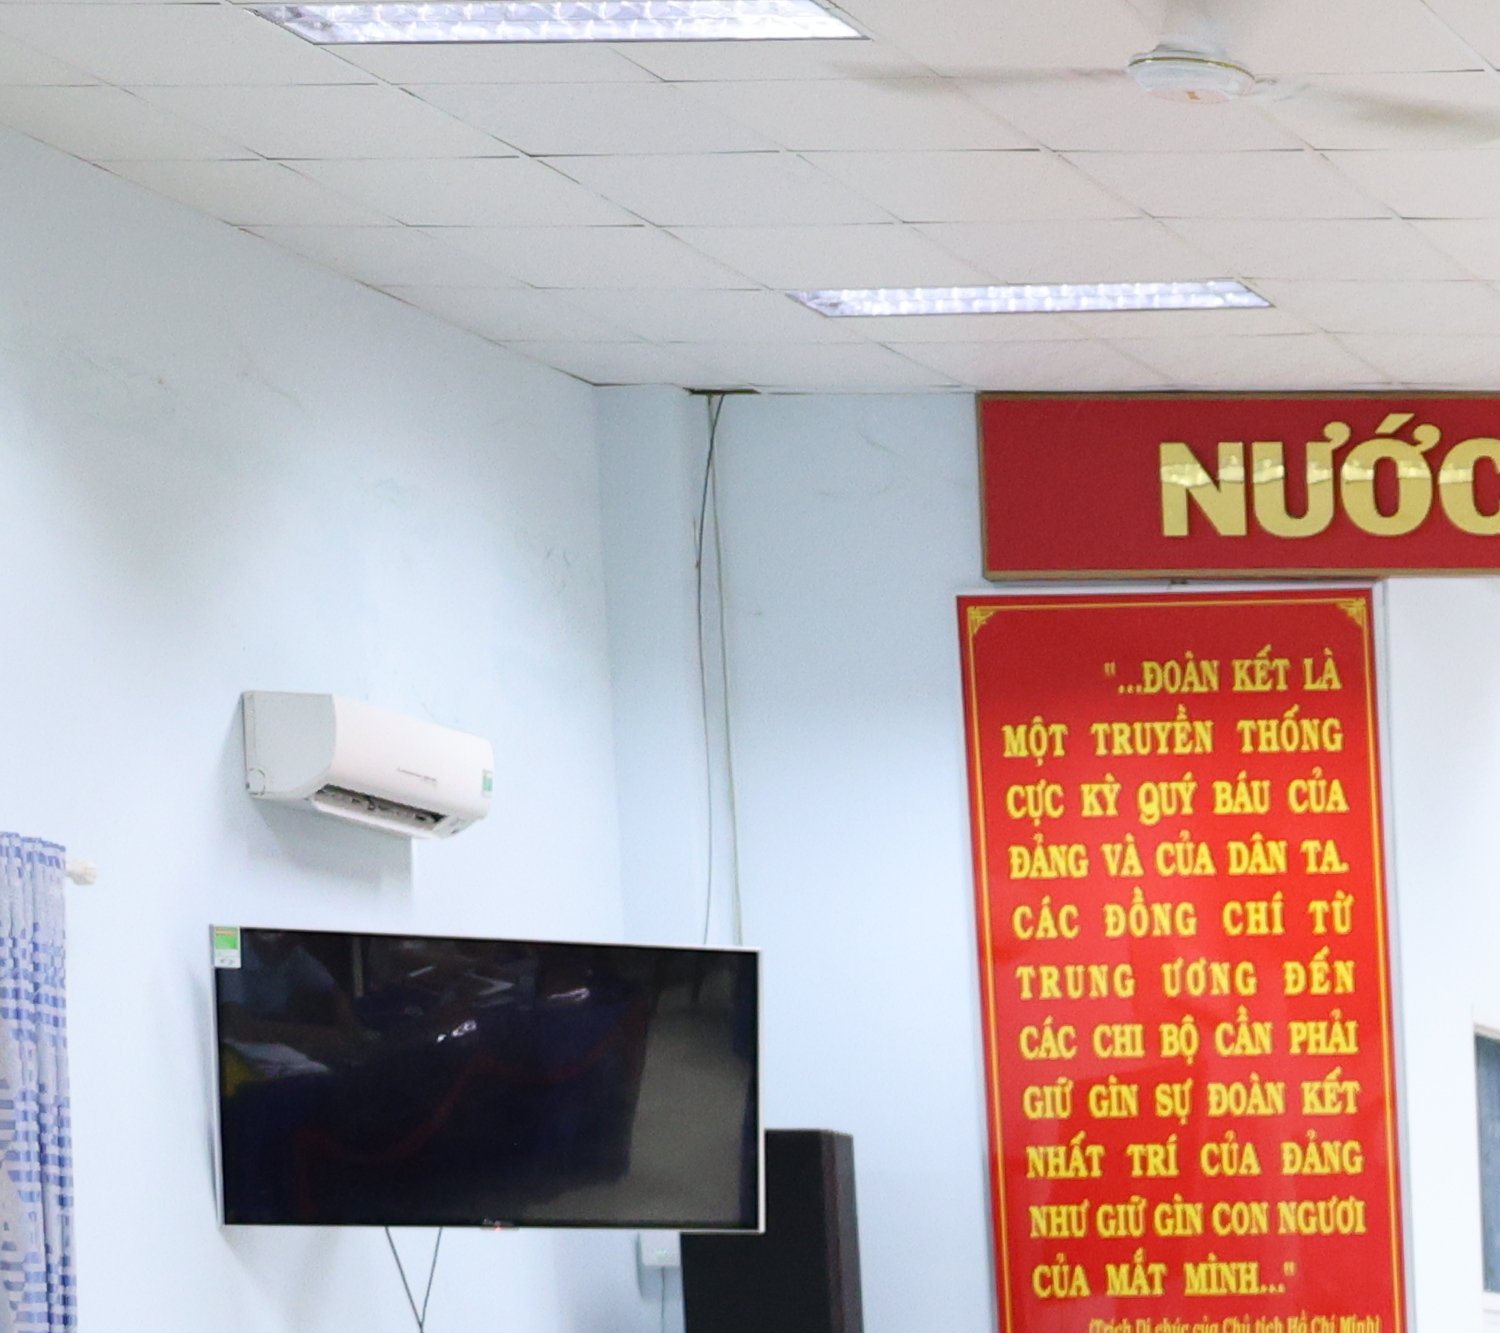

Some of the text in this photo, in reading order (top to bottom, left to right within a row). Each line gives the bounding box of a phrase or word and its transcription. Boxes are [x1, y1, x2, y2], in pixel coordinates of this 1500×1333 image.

[1232, 644, 1290, 691] KẾT
[1302, 647, 1342, 690] LÀ
[1001, 704, 1343, 765] MỘT TRUYỀN THỐNG
[1008, 829, 1349, 879] ĐẢNG VÀ CỦA DÂN TA.
[1022, 1066, 1360, 1124] GIỮ GÌN SỰ ĐOÀN KẾT
[1032, 1253, 1090, 1297] CỦA
[1105, 1248, 1166, 1296] MẮT
